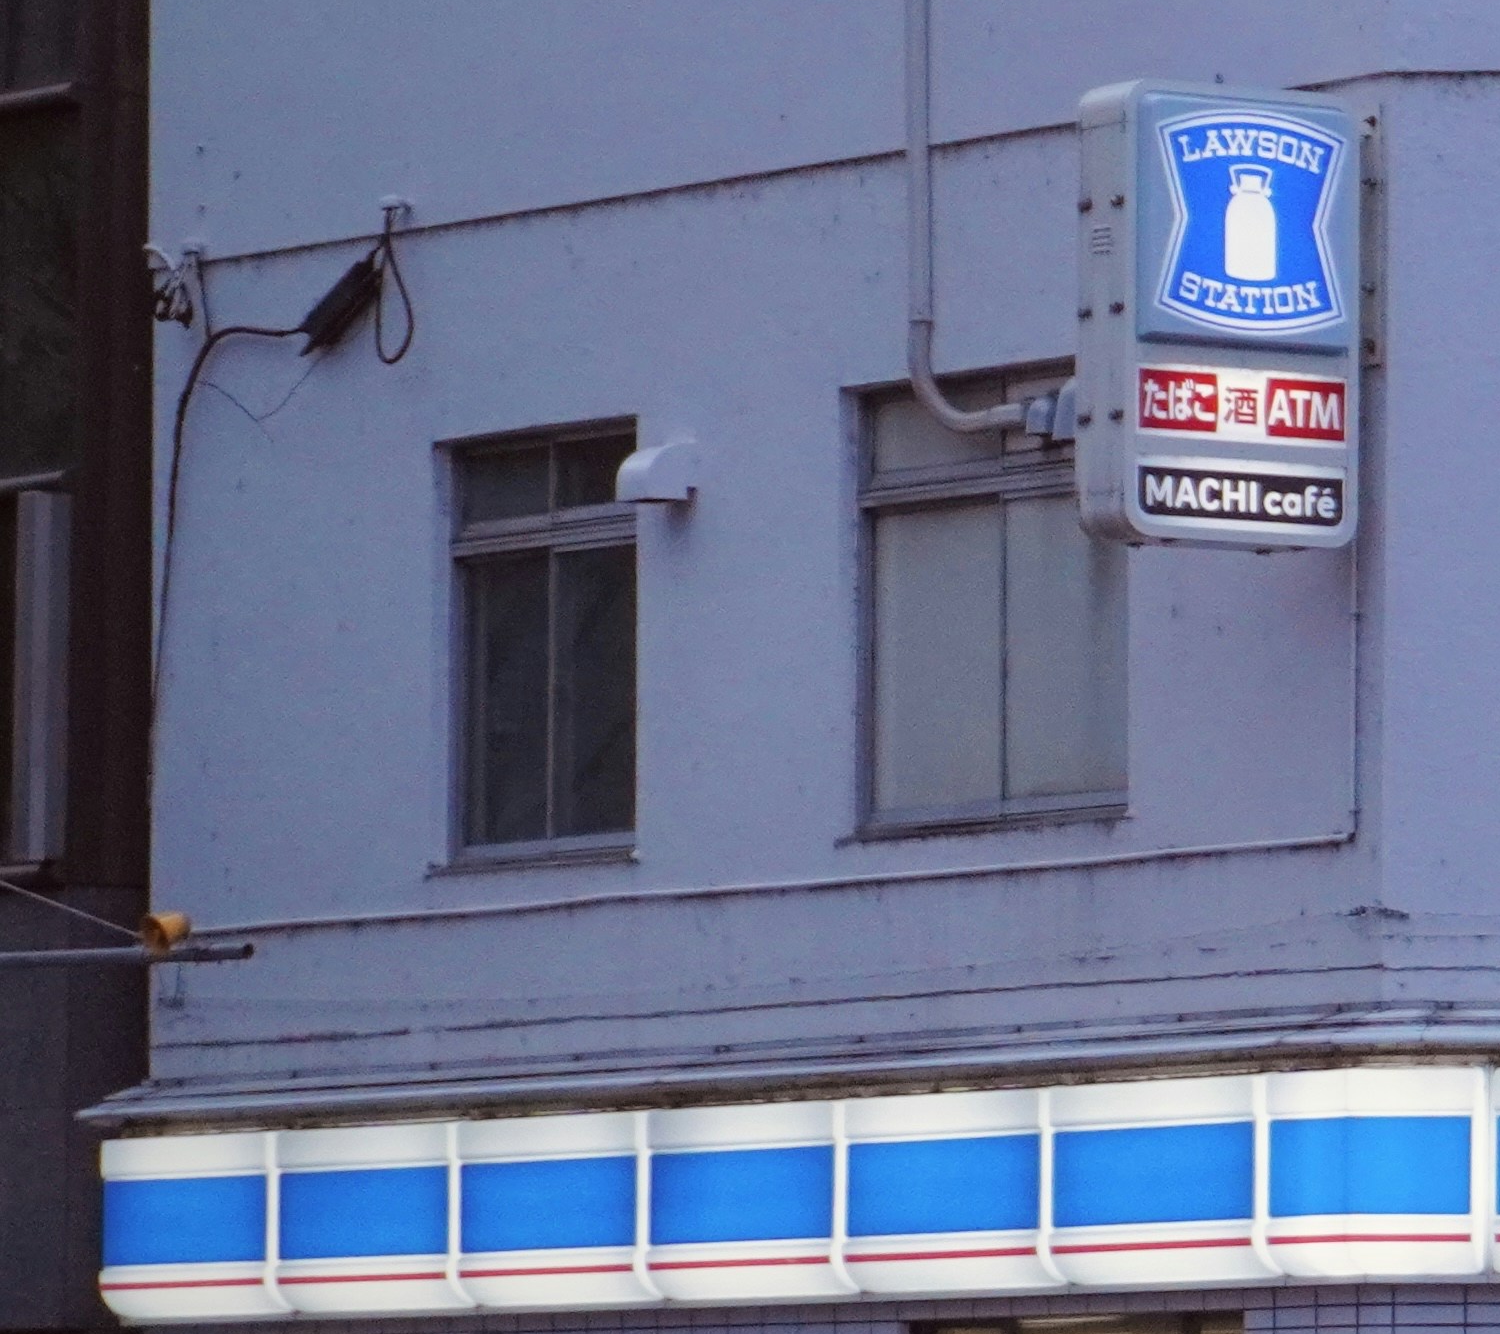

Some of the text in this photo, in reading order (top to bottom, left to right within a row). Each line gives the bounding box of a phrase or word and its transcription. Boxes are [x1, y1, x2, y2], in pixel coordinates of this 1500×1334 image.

[1177, 127, 1326, 175] LAWSON
[1178, 271, 1322, 315] STATION
[1142, 376, 1342, 432] たばこ 酒 ATM
[1144, 472, 1338, 519] MACHI café
